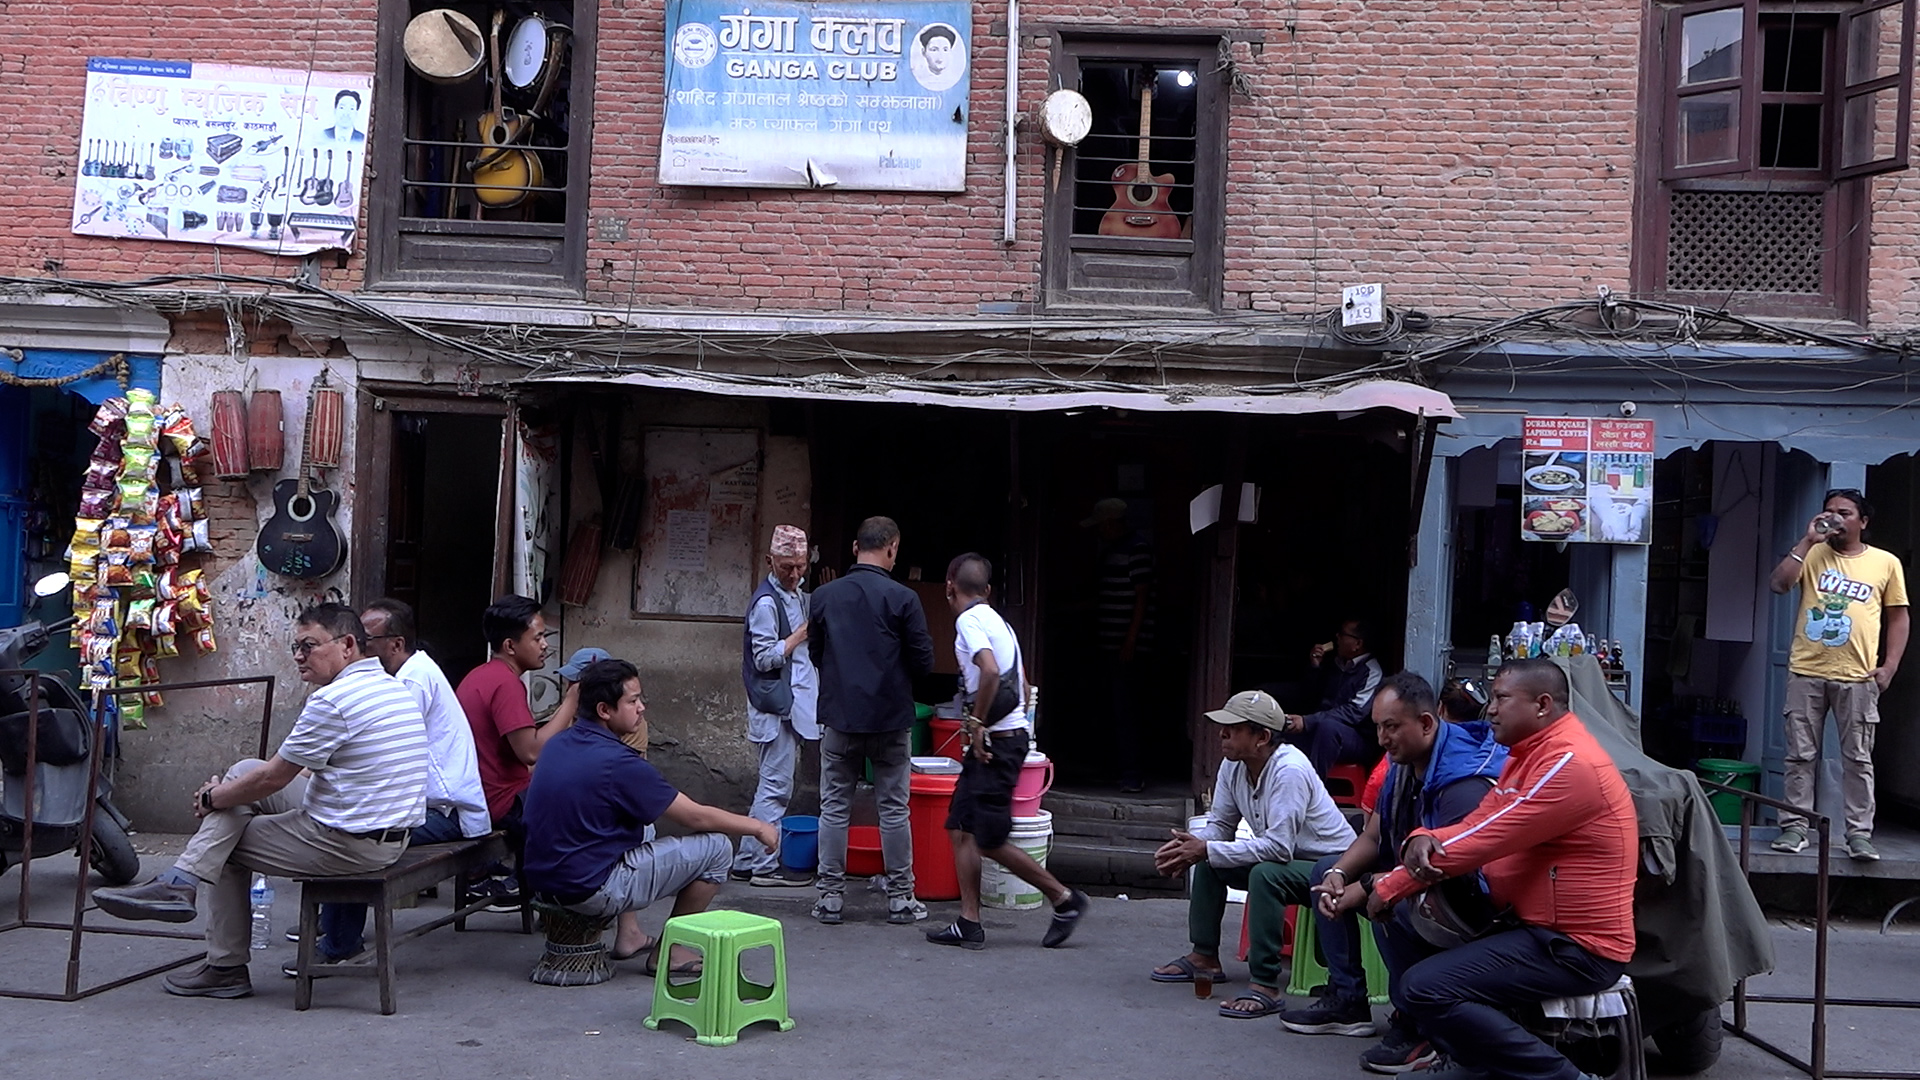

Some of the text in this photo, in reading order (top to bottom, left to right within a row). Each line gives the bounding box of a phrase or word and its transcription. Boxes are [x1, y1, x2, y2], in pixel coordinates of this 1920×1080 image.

[719, 8, 799, 52] गंगा
[726, 59, 898, 82] GANGA CLUB
[722, 90, 791, 106] गंगालाल
[879, 156, 922, 169] Package
[1525, 420, 1587, 429] DURBAR SQUARE
